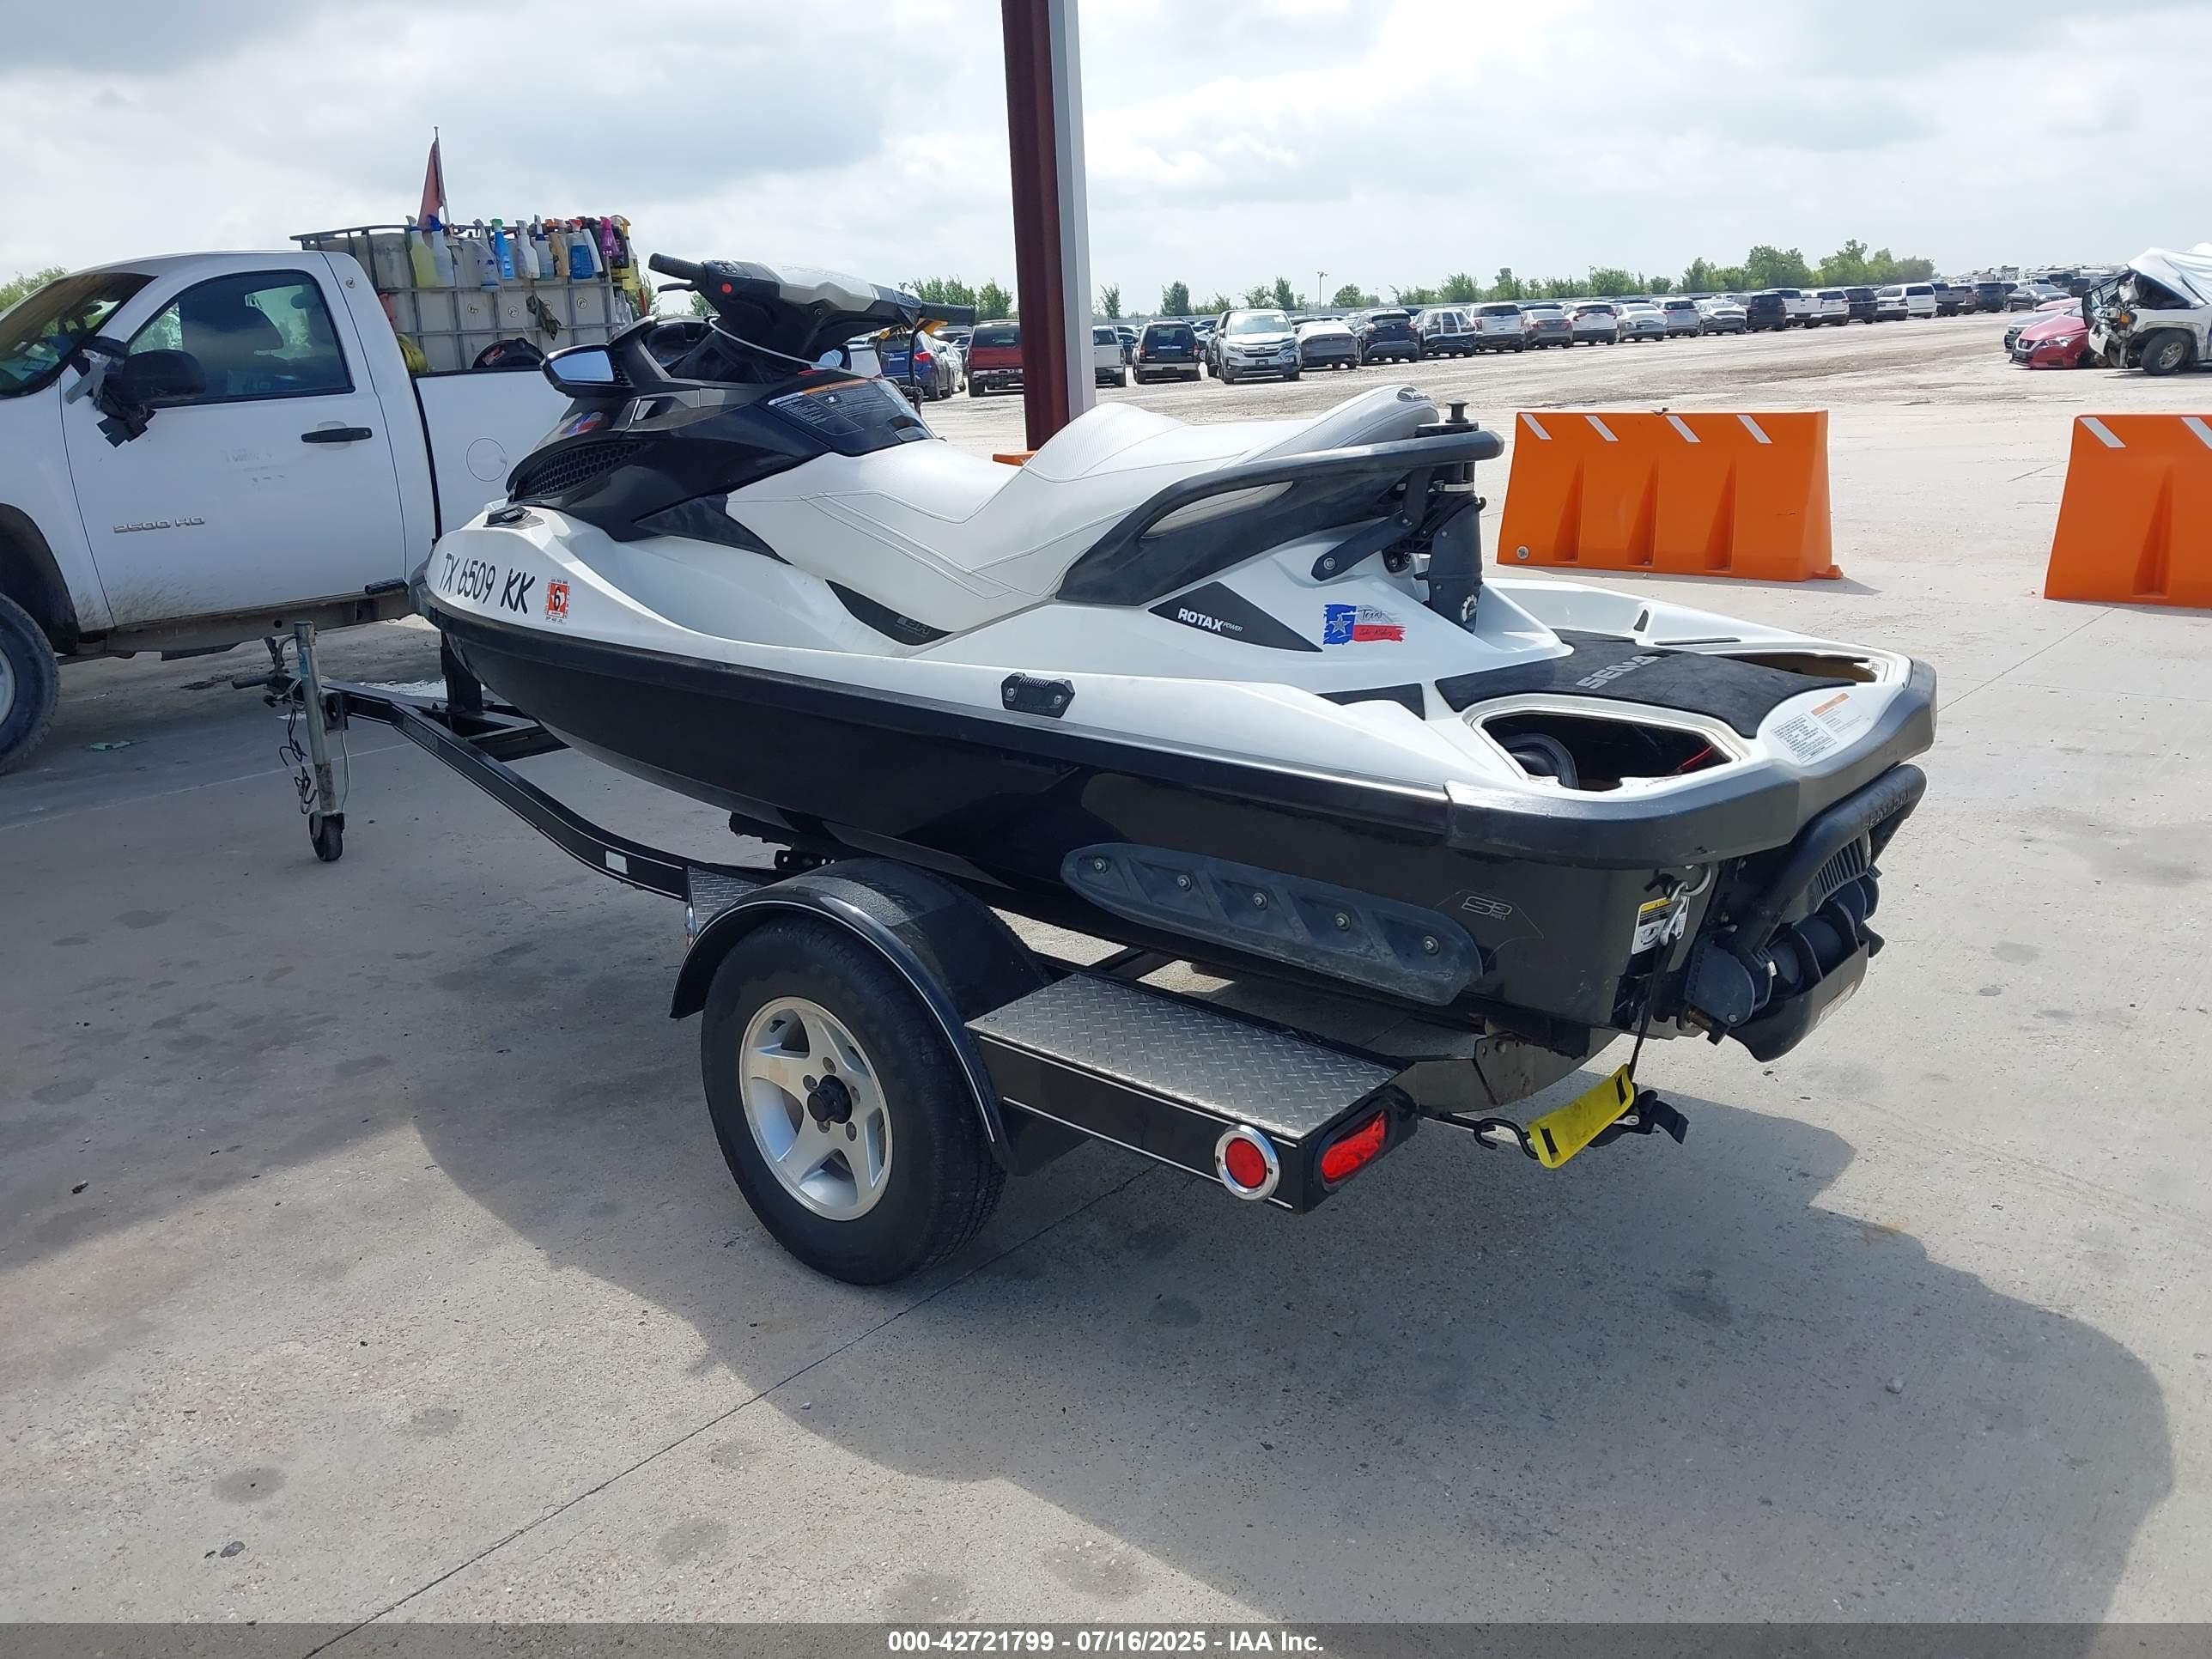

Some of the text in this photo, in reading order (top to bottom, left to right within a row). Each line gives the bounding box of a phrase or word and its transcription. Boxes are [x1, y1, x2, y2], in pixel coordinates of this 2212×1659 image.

[113, 517, 205, 533] 2500 HD
[439, 552, 460, 593] TX
[457, 557, 496, 605] 6509
[500, 568, 536, 615] KK
[554, 586, 562, 611] 6
[1177, 607, 1224, 632] ROTAX
[1358, 608, 1383, 619] Texas
